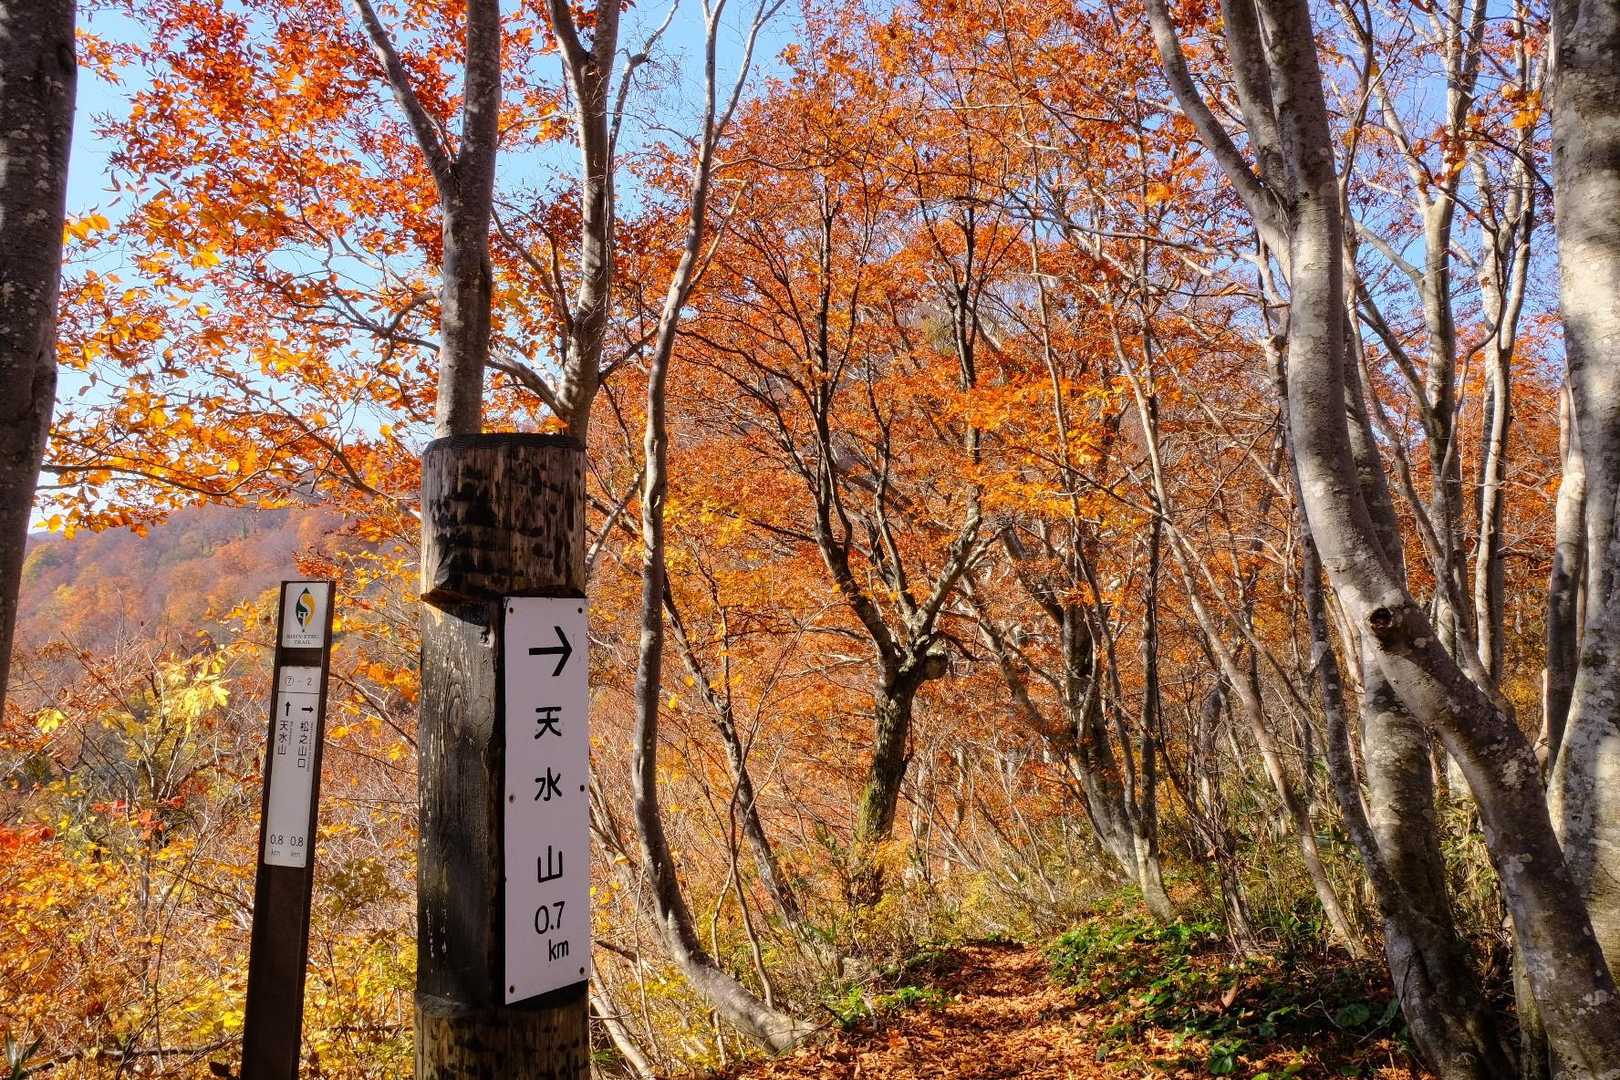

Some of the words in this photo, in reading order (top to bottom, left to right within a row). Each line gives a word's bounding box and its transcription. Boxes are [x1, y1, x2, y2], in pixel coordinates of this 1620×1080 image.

[278, 720, 289, 755] 天水山
[297, 721, 309, 768] 松之山口
[534, 706, 563, 883] 天水山
[270, 834, 284, 846] 0.8
[290, 836, 304, 847] 0.8
[534, 901, 566, 935] 0.7
[548, 938, 569, 962] km
